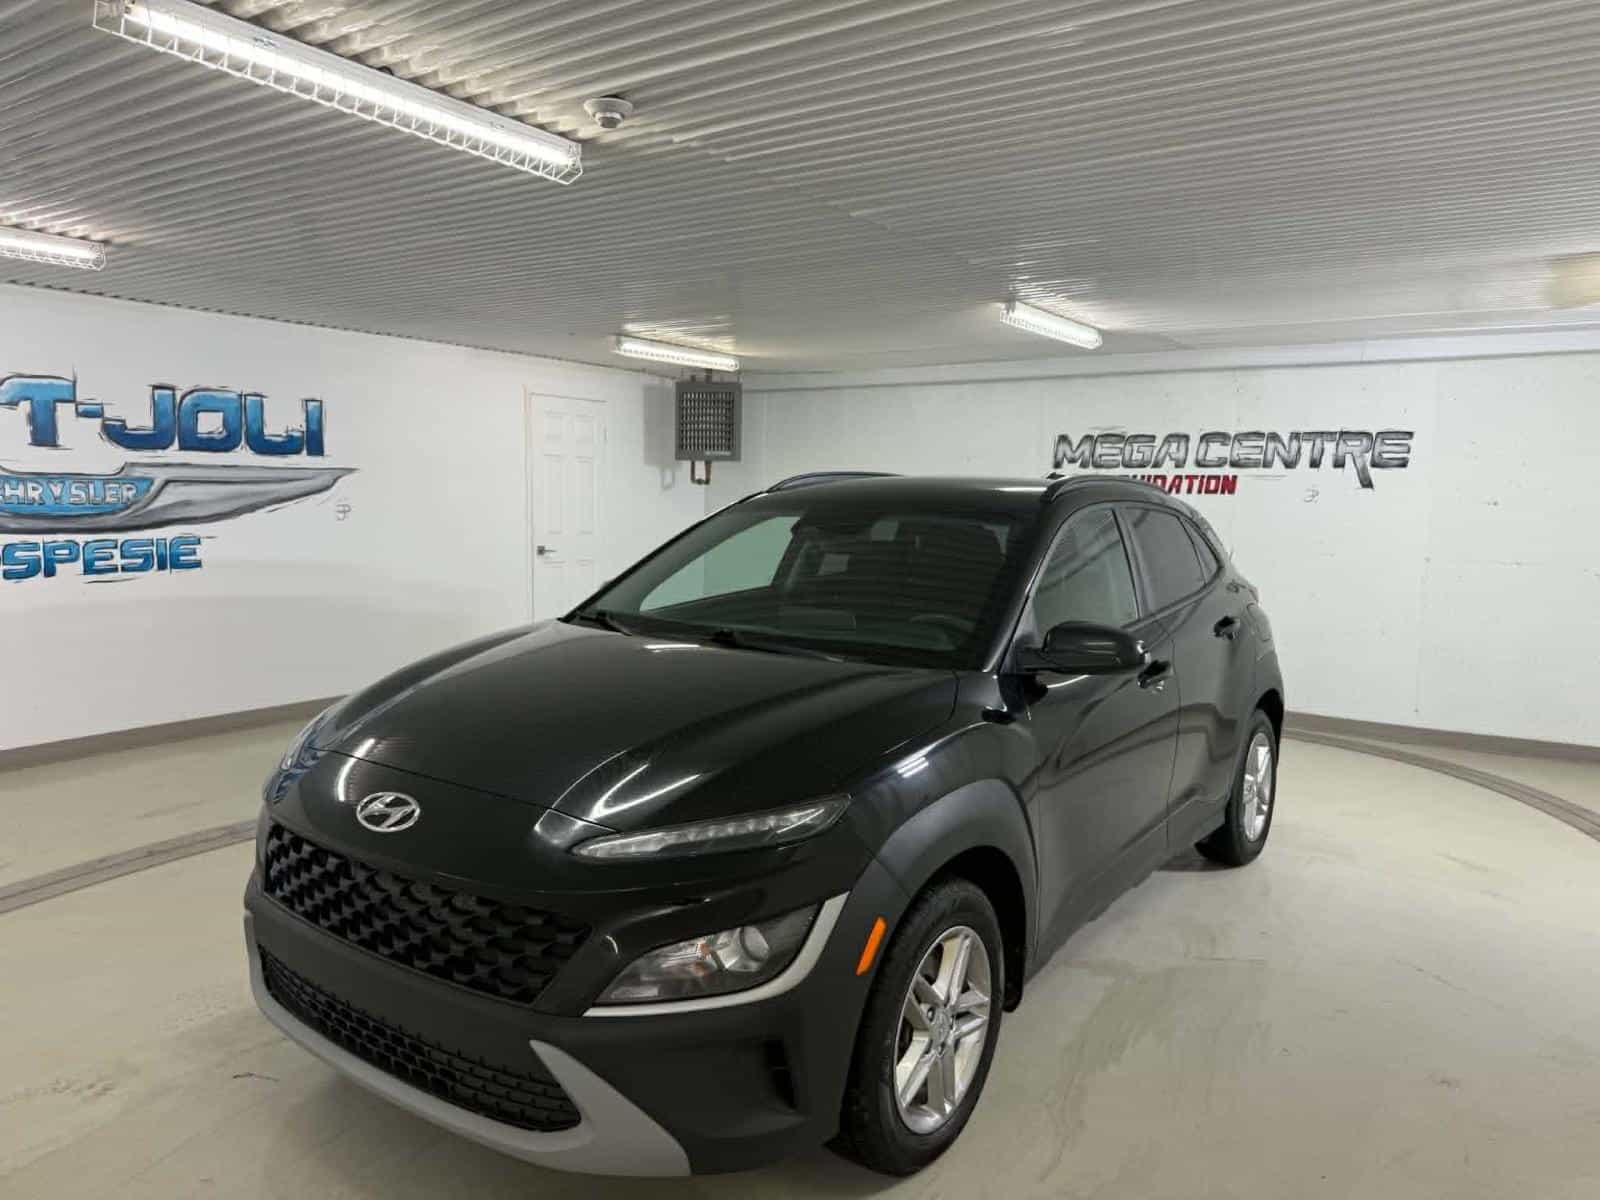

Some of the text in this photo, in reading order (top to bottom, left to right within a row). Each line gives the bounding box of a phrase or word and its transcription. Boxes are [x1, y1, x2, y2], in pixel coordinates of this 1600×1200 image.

[0, 375, 325, 456] T-JOLI
[1053, 430, 1414, 488] MEGA CENTRE
[0, 479, 138, 505] HRYSLER
[1132, 474, 1238, 495] DATION
[0, 536, 202, 581] SPESIE
